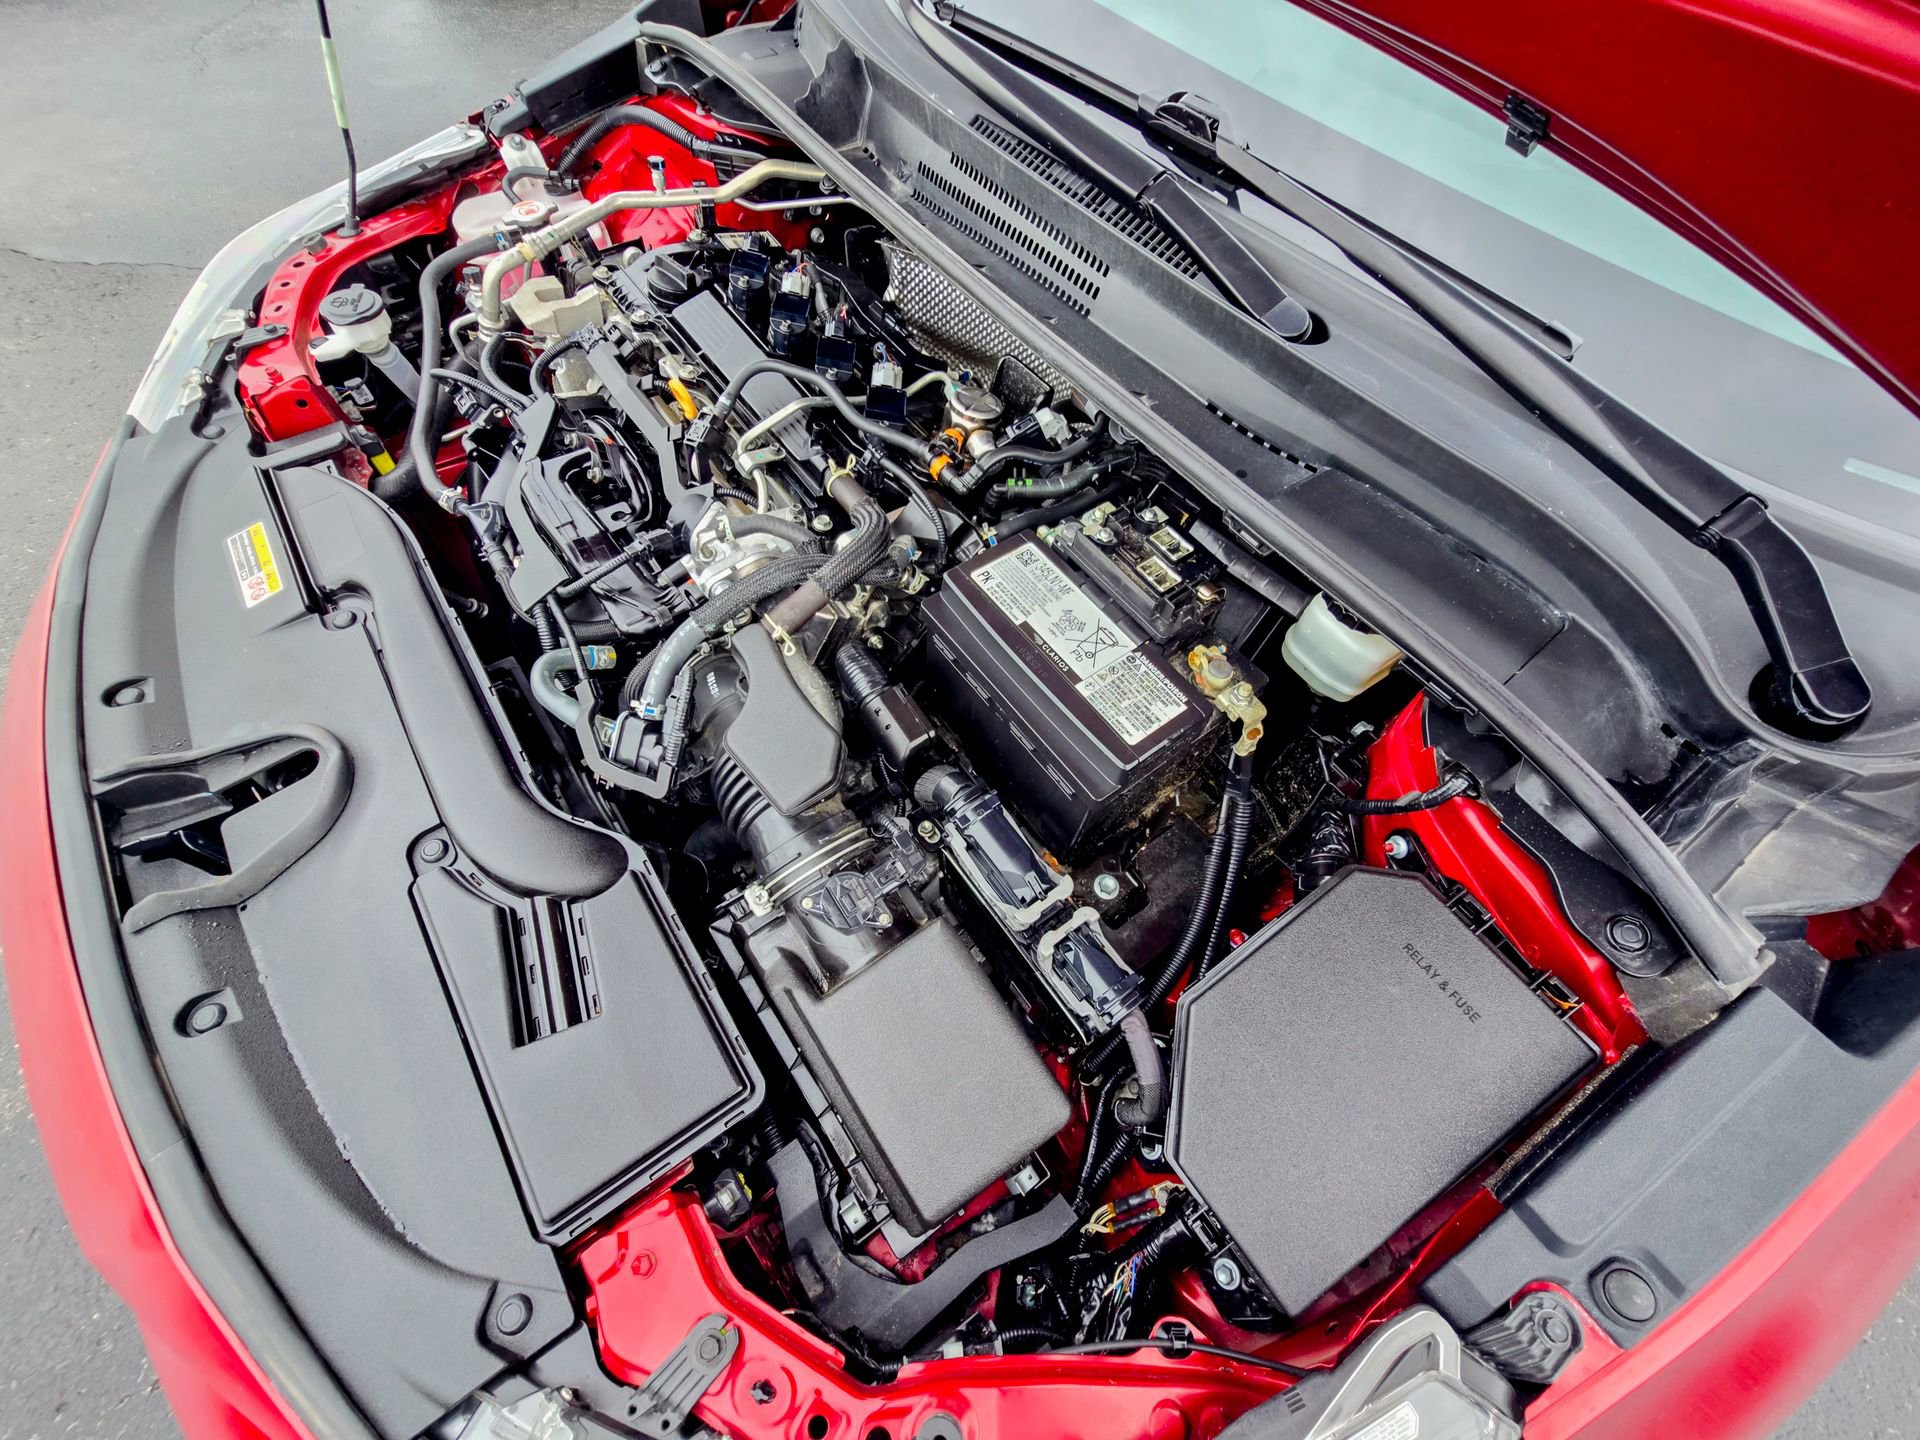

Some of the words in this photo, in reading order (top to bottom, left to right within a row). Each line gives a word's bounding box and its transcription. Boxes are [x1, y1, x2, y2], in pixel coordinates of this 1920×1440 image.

[976, 570, 995, 585] PK
[1041, 644, 1070, 672] CLARIOS
[1069, 649, 1084, 663] Pb
[1139, 653, 1188, 704] DANGER/POISON
[1402, 943, 1441, 980] RELAY
[1438, 980, 1450, 992] &
[1448, 990, 1482, 1024] FUSE
